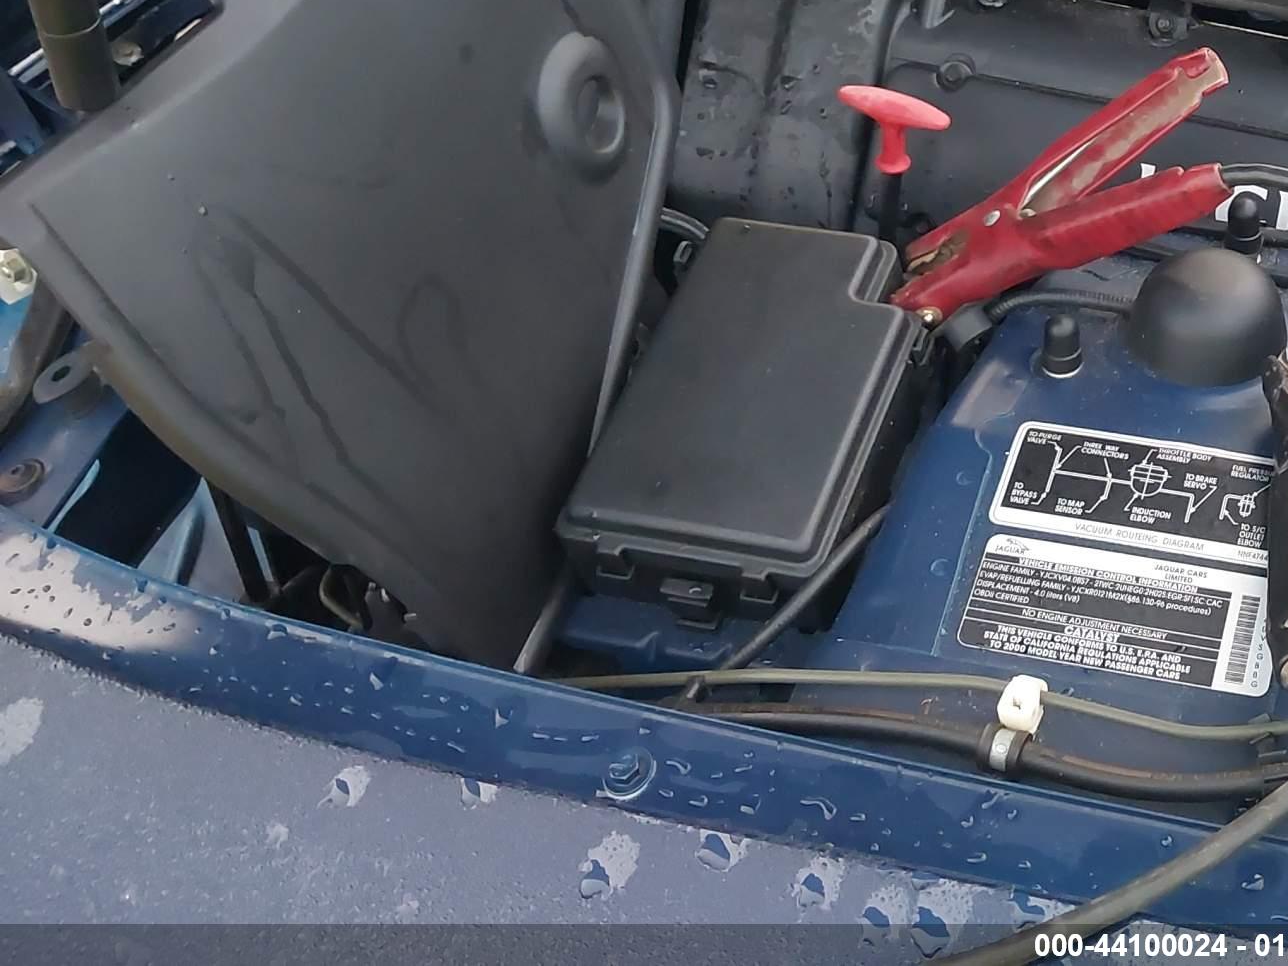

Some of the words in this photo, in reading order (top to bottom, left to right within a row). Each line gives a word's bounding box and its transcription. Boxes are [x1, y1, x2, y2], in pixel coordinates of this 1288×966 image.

[1026, 437, 1046, 445] VALVE
[1081, 448, 1130, 460] CONNECTORS
[1156, 454, 1191, 464] ASSEMBLY
[1192, 454, 1213, 462] BODY
[1184, 480, 1207, 490] SERVO
[1195, 475, 1218, 484] BRAKE
[1012, 489, 1038, 498] BYPASS
[1010, 496, 1030, 504] VALVE
[1067, 500, 1085, 508] MAP
[1055, 505, 1083, 516] SENSOR
[1131, 506, 1172, 520] INDUCTION
[1129, 513, 1155, 524] ELBOW
[1240, 523, 1251, 532] TO
[1252, 525, 1266, 534] S/C
[1074, 522, 1113, 535] VACUUM
[1115, 529, 1159, 543] ROUTEING
[1162, 537, 1205, 552] DIAGRAM
[1239, 532, 1265, 541] OUTLET
[1237, 538, 1263, 548] ELBOW
[994, 544, 1025, 554] JAGUAR
[982, 561, 1010, 572] ENGINE
[1011, 566, 1036, 576] FAMILY
[1154, 564, 1185, 575] JAGUAR
[1187, 569, 1208, 579] CARS
[1018, 557, 1054, 570] VEHICLE
[1054, 563, 1094, 576] EMISSION
[1095, 569, 1138, 584] CONTROL
[1138, 576, 1198, 594] INFORMATION
[1164, 573, 1193, 584] LIMITED
[976, 579, 1030, 594] DISPLACEMENT
[1034, 589, 1046, 597] 4.0
[1064, 594, 1080, 604] (V8)
[980, 570, 1040, 586] EVAP/REFUELLING
[1041, 580, 1066, 591] FAMILY
[1166, 602, 1212, 616] procedures)
[995, 592, 1030, 604] CERTIFIED
[1022, 608, 1036, 617] NO
[1037, 610, 1068, 624] ENGINE
[1068, 617, 1121, 632] ADJUSTMENT
[1121, 626, 1168, 640] NECESSARY
[1064, 625, 1120, 643] CATALYST
[998, 625, 1016, 634] THIS
[1018, 628, 1052, 640] VEHICLE
[1054, 632, 1104, 652] CONFORMS
[1106, 642, 1118, 652] TO
[1120, 646, 1136, 656] U.S.
[1137, 649, 1160, 660] E.P.A.
[1161, 652, 1182, 664] AND
[984, 631, 1008, 642] STATE
[1010, 636, 1022, 645] OF
[1023, 637, 1076, 654] CALIFORNIA
[1077, 645, 1137, 664] REGULATIONS
[1137, 656, 1192, 674] APPLICABLE
[990, 640, 1002, 649] TO
[1003, 642, 1026, 654] 2000
[1027, 646, 1058, 659] MODEL
[1058, 650, 1082, 664] YEAR
[1082, 654, 1104, 666] NEW
[1104, 660, 1155, 676] PASSENGER
[1156, 668, 1181, 680] CARS
